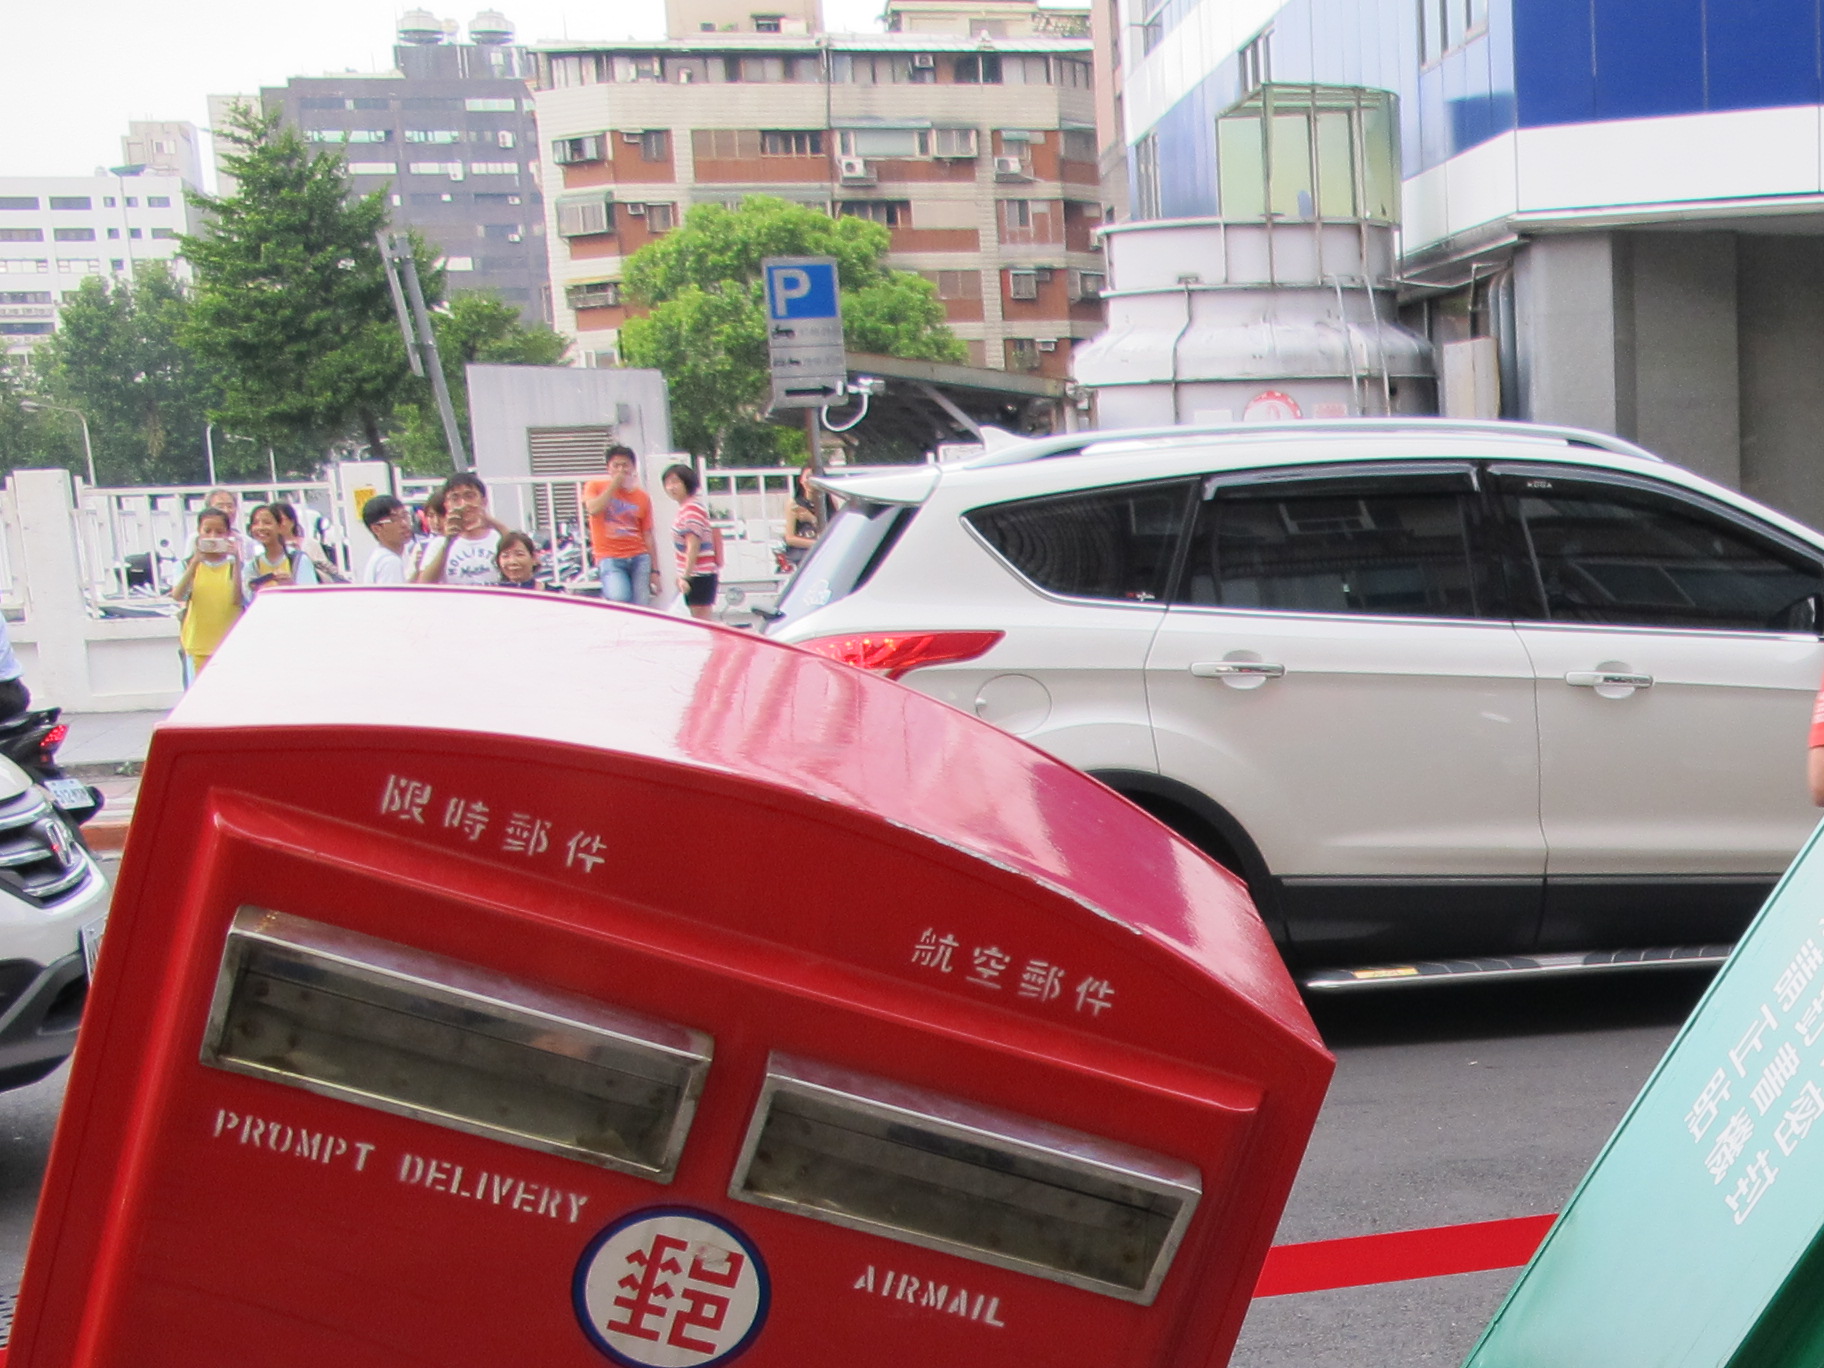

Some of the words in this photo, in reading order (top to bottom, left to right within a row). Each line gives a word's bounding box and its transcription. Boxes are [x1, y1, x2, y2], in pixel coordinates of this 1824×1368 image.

[773, 268, 811, 317] P
[447, 548, 497, 576] HOLLIST
[380, 774, 607, 873] 限時郵件
[911, 927, 1115, 1016] 航空郵件
[212, 1108, 376, 1172] PROMPT
[398, 1153, 590, 1224] DELIVERY
[853, 1263, 1005, 1328] AIRMAIL
